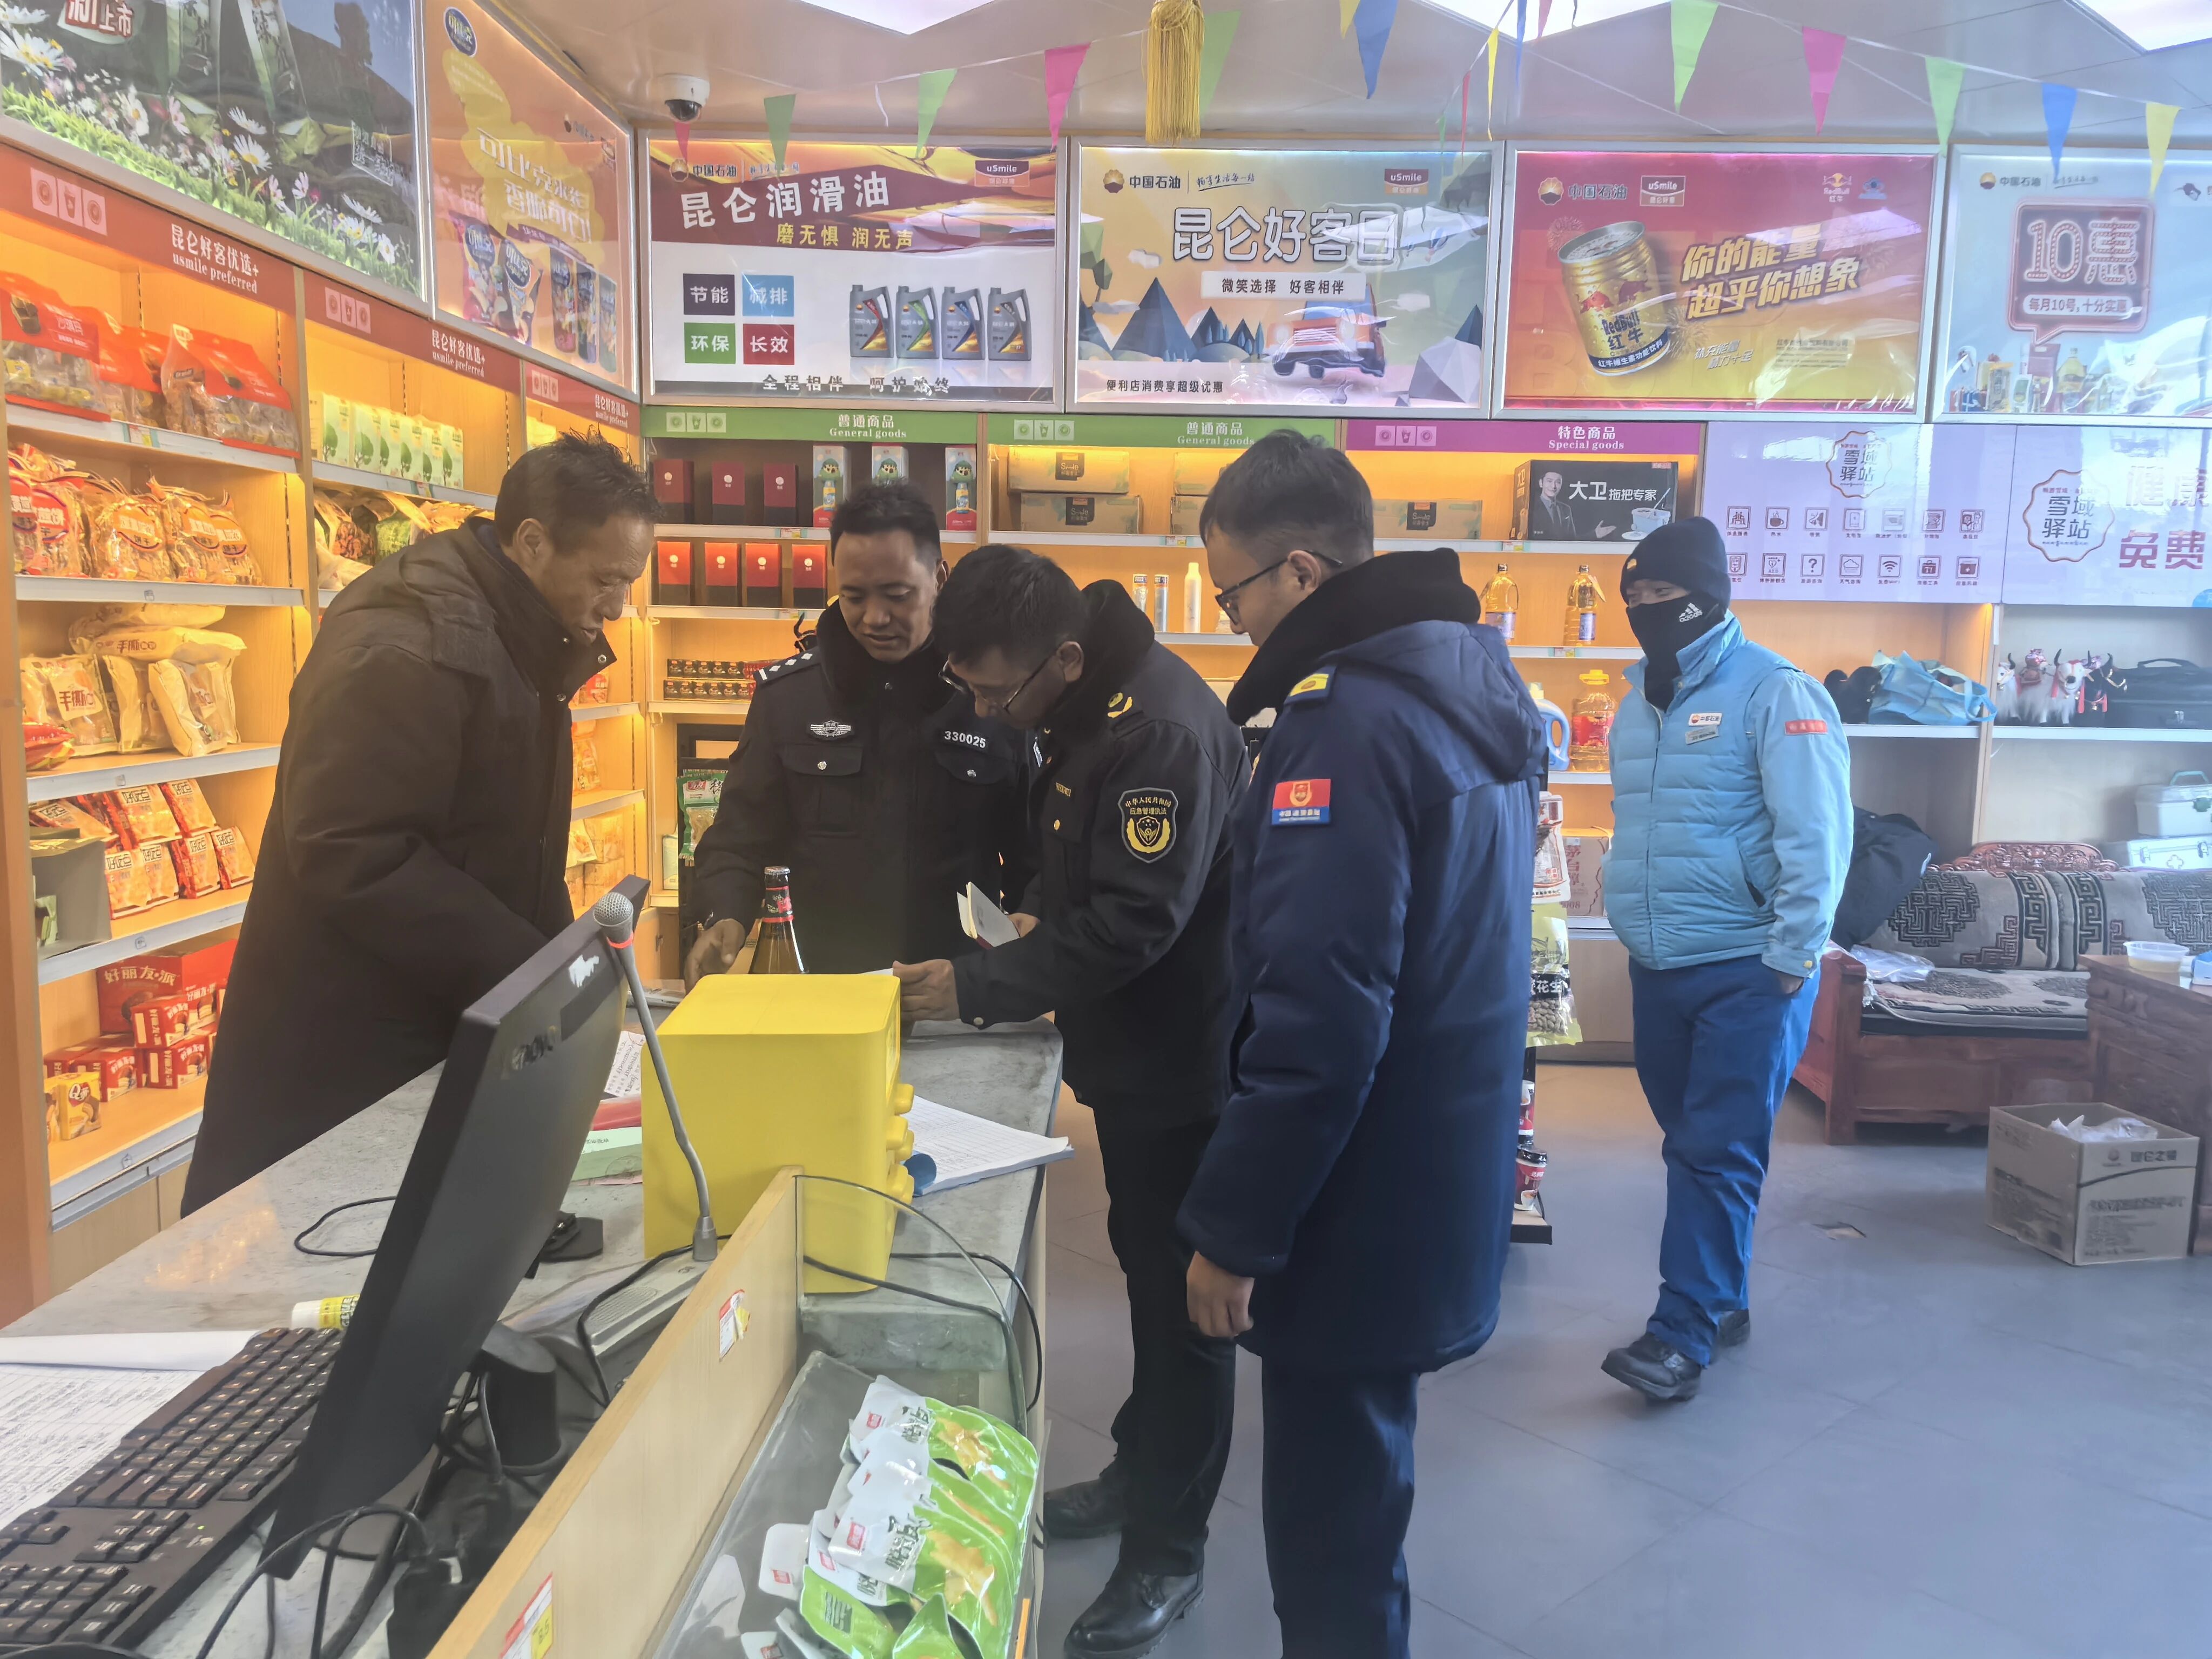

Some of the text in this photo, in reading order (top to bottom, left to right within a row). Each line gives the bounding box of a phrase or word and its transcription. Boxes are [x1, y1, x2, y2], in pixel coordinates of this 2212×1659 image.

[693, 165, 737, 177] 中国石油
[1391, 173, 1422, 181] uSmile
[1129, 175, 1181, 189] 中国石油
[1648, 181, 1678, 190] uSmile
[2000, 176, 2041, 186] 中国石油
[681, 171, 889, 228] 昆仑润滑油
[1568, 184, 1628, 200] 中国石油
[777, 224, 914, 249] 磨无惧 润无声
[1172, 206, 1400, 263] 昆仑好客日
[1681, 223, 1821, 281] 你的能量
[2023, 217, 2140, 285] 10惠
[173, 253, 258, 294] usmile preferred
[690, 286, 729, 305] 节能
[1222, 279, 1344, 295] 微笑选择 好客相伴
[1688, 259, 1860, 320] 超乎你想象
[750, 286, 788, 306] 减排
[691, 335, 730, 352] 环保
[750, 335, 788, 354] 长效
[1608, 327, 1644, 350] 红牛
[433, 351, 485, 377] usmile preferred
[763, 374, 844, 392] 全程相伴
[1106, 379, 1224, 394] 便利店消费享超级优惠
[838, 414, 894, 428] 普通商品
[1186, 422, 1243, 436] 普通商品
[829, 428, 907, 439] General goods
[1177, 435, 1255, 446] General goods
[1558, 426, 1616, 440] 特色商品
[1548, 440, 1624, 451] Special goods
[1843, 449, 1878, 466] 雪域
[1839, 466, 1875, 482] 驿站
[1568, 481, 1657, 502] 大卫 拖把专家
[2047, 496, 2096, 517] 雪域
[2041, 518, 2092, 539] 驿站
[2119, 529, 2207, 570] 免费
[1678, 609, 1703, 623] adidas
[944, 731, 986, 749] 330025
[1124, 797, 1172, 808] 中华人民共和国
[1130, 807, 1167, 815] 应急管理执法
